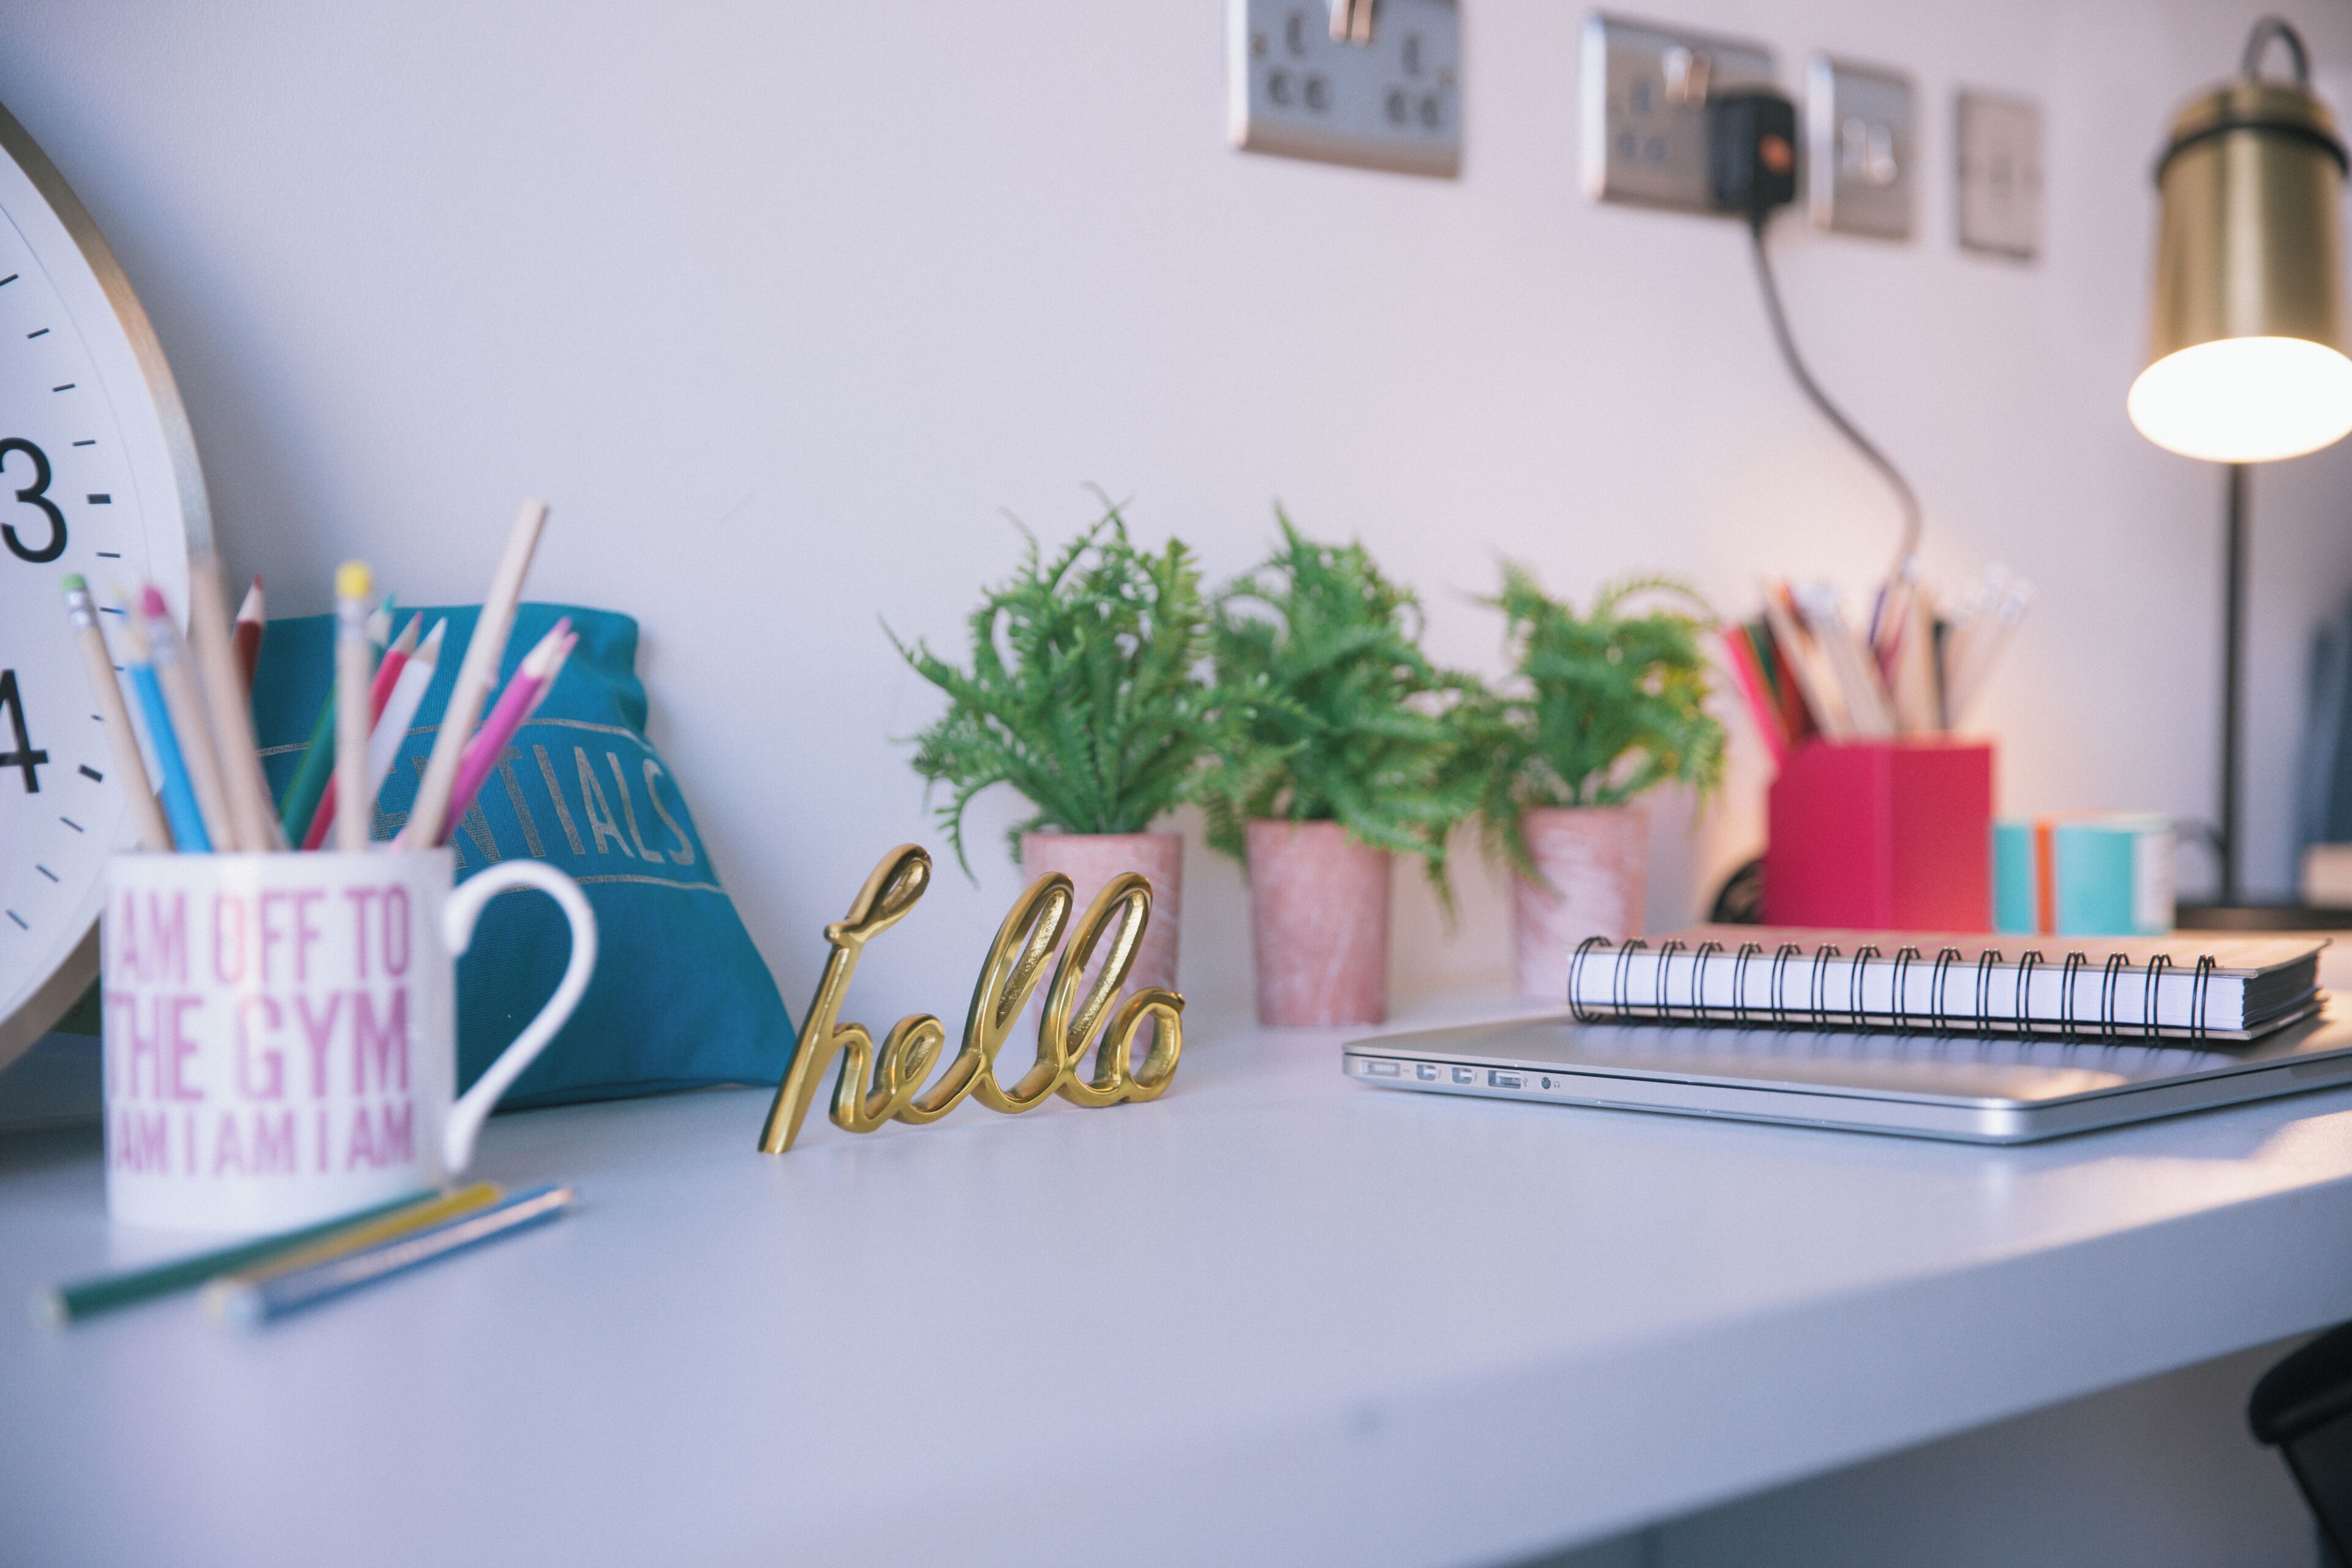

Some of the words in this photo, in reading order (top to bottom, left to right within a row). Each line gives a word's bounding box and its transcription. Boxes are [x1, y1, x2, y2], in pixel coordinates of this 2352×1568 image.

[0, 437, 67, 564] 3
[210, 887, 326, 986] OFF
[342, 882, 411, 980] TO
[102, 990, 205, 1102] THE
[236, 986, 412, 1103] GYM
[758, 843, 1185, 1154] hello
[213, 1110, 296, 1176] AM
[345, 1100, 417, 1171] AM
